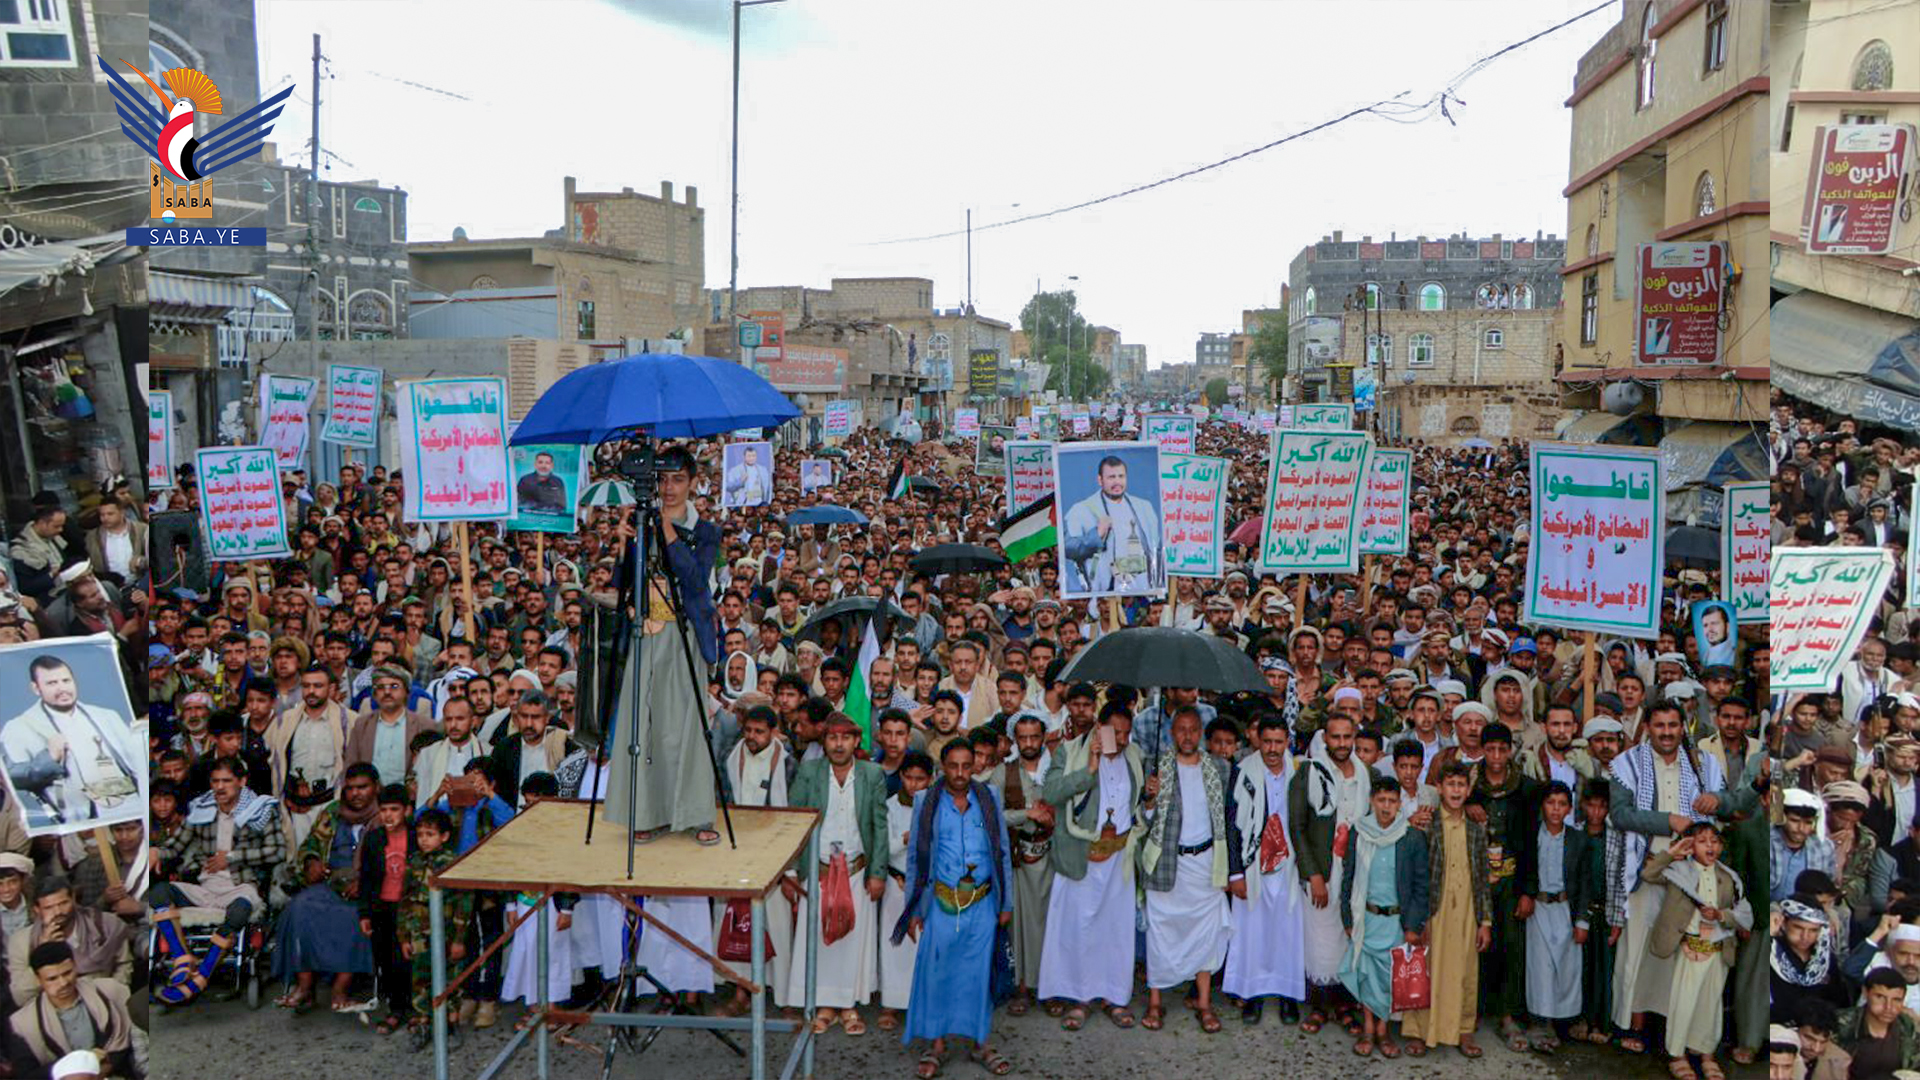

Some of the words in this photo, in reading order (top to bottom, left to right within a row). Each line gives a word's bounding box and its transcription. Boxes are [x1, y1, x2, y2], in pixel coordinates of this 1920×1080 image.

[1849, 152, 1898, 187] الزين
[1820, 188, 1852, 201] الذكية
[1853, 188, 1896, 201] للهواتف
[1668, 267, 1718, 300] الزين
[1642, 303, 1673, 315] الذكية
[1675, 303, 1717, 315] للهواتف
[360, 372, 379, 386] الله
[417, 385, 498, 423] قاطعوا
[1176, 421, 1194, 433] الله
[1327, 410, 1346, 424] الله
[420, 425, 462, 453] الأمريكية
[463, 425, 502, 451] البضائع
[1282, 438, 1333, 468] أكبر
[1331, 441, 1363, 463] الله
[206, 453, 243, 481] أكبر
[246, 455, 271, 473] الله
[457, 455, 465, 475] و
[1161, 459, 1193, 479] أك
[1192, 461, 1219, 482] الله
[1380, 456, 1405, 473] الله
[206, 478, 242, 496] لأمريكا
[243, 478, 274, 494] الموت
[1279, 467, 1321, 489] لأمريكا
[1323, 470, 1357, 488] الموت
[1374, 479, 1403, 492] الموت
[1543, 467, 1650, 502] قاطعوا
[424, 480, 505, 508] الإسرائيلية
[1185, 487, 1216, 504] الموت
[1275, 492, 1318, 513] لإسرائيل
[1320, 494, 1353, 511] الموت
[210, 498, 245, 516] لإسرائيل
[246, 496, 277, 513] الموت
[211, 517, 237, 533] اليهود
[1183, 508, 1214, 525] الموت
[1272, 515, 1302, 535] اليهود
[1304, 516, 1320, 534] على
[1324, 514, 1349, 531] اللعنة
[1543, 509, 1597, 540] الأمريكية
[1171, 527, 1186, 544] على
[1190, 527, 1213, 544] اللعنة
[1597, 512, 1650, 543] البضائع
[216, 533, 249, 552] للإسلام
[254, 530, 281, 551] النصر
[1311, 534, 1347, 562] النصر
[1370, 529, 1400, 549] النصر
[1180, 546, 1213, 568] النصر
[1269, 537, 1310, 563] للإسلام
[1586, 547, 1596, 570] و
[1773, 559, 1840, 590] أكبر
[1833, 562, 1876, 583] الله
[1540, 575, 1648, 612] الإسرائيلية
[1817, 591, 1863, 608] الموت
[1806, 616, 1852, 631] الموت
[1782, 640, 1801, 655] على
[1781, 655, 1830, 681] النصر
